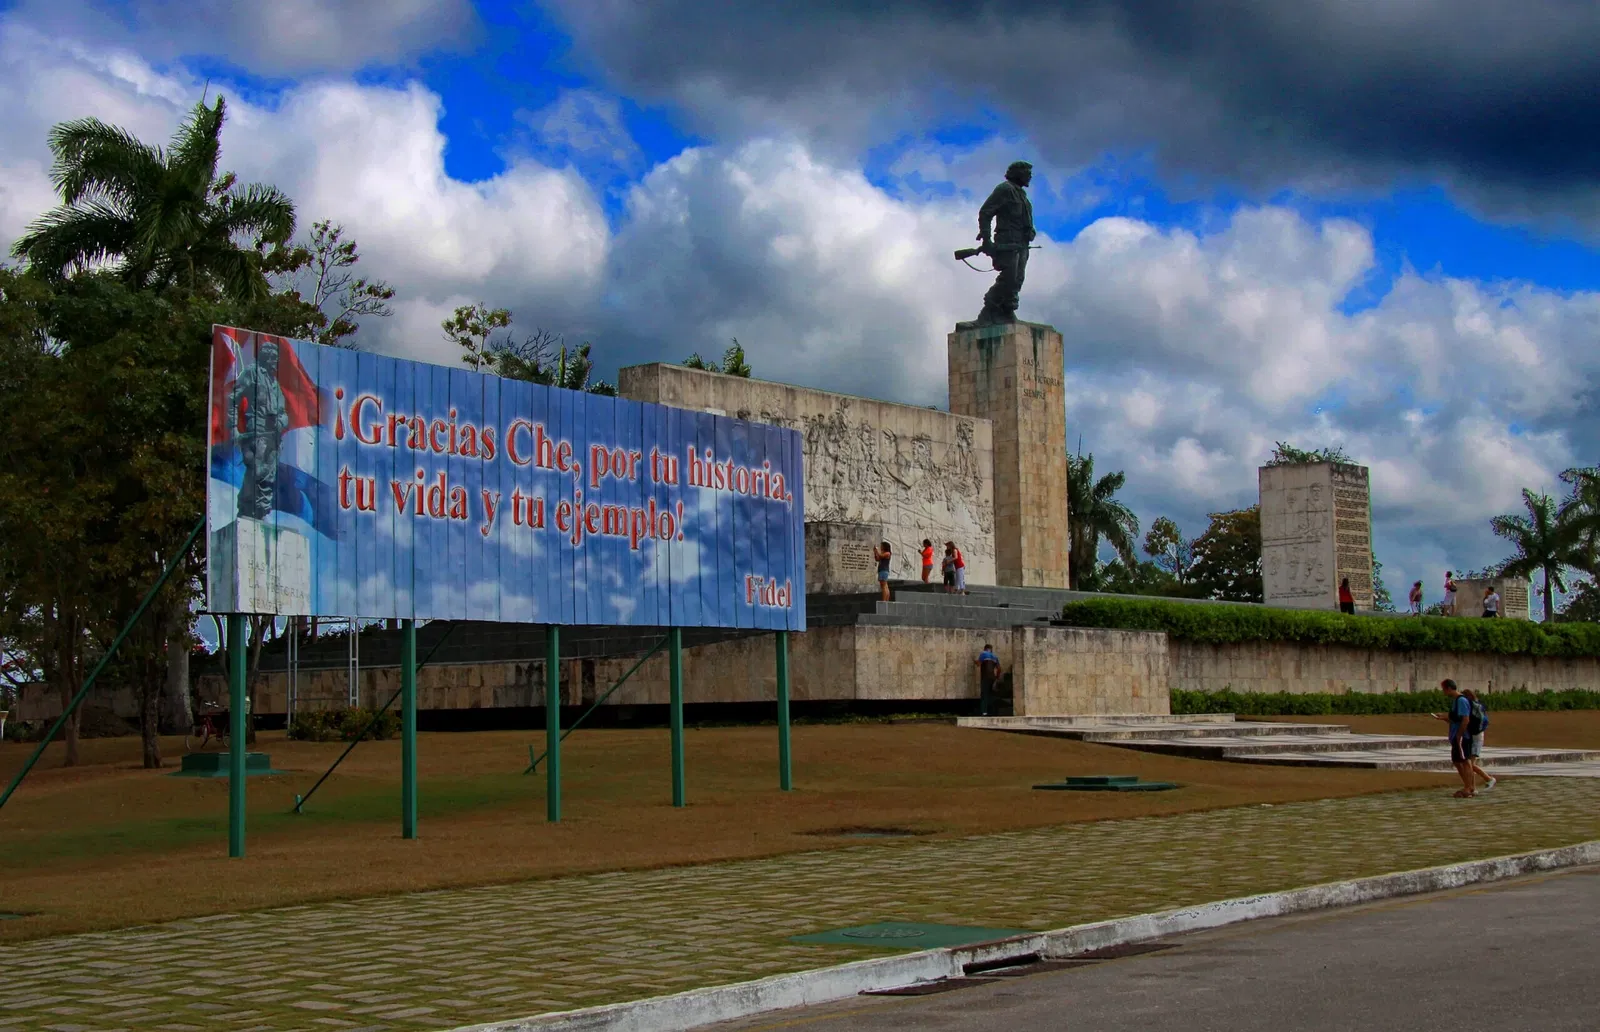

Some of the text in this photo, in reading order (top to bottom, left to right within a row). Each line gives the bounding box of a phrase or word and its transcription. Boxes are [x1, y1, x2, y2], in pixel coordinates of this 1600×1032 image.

[1023, 357, 1040, 367] HASA
[1023, 373, 1031, 381] LA
[335, 388, 793, 510] ¡Gracias Che, por tu historia,
[338, 464, 684, 551] tu vida y tu ejemplo!
[745, 574, 792, 607] Fidel
